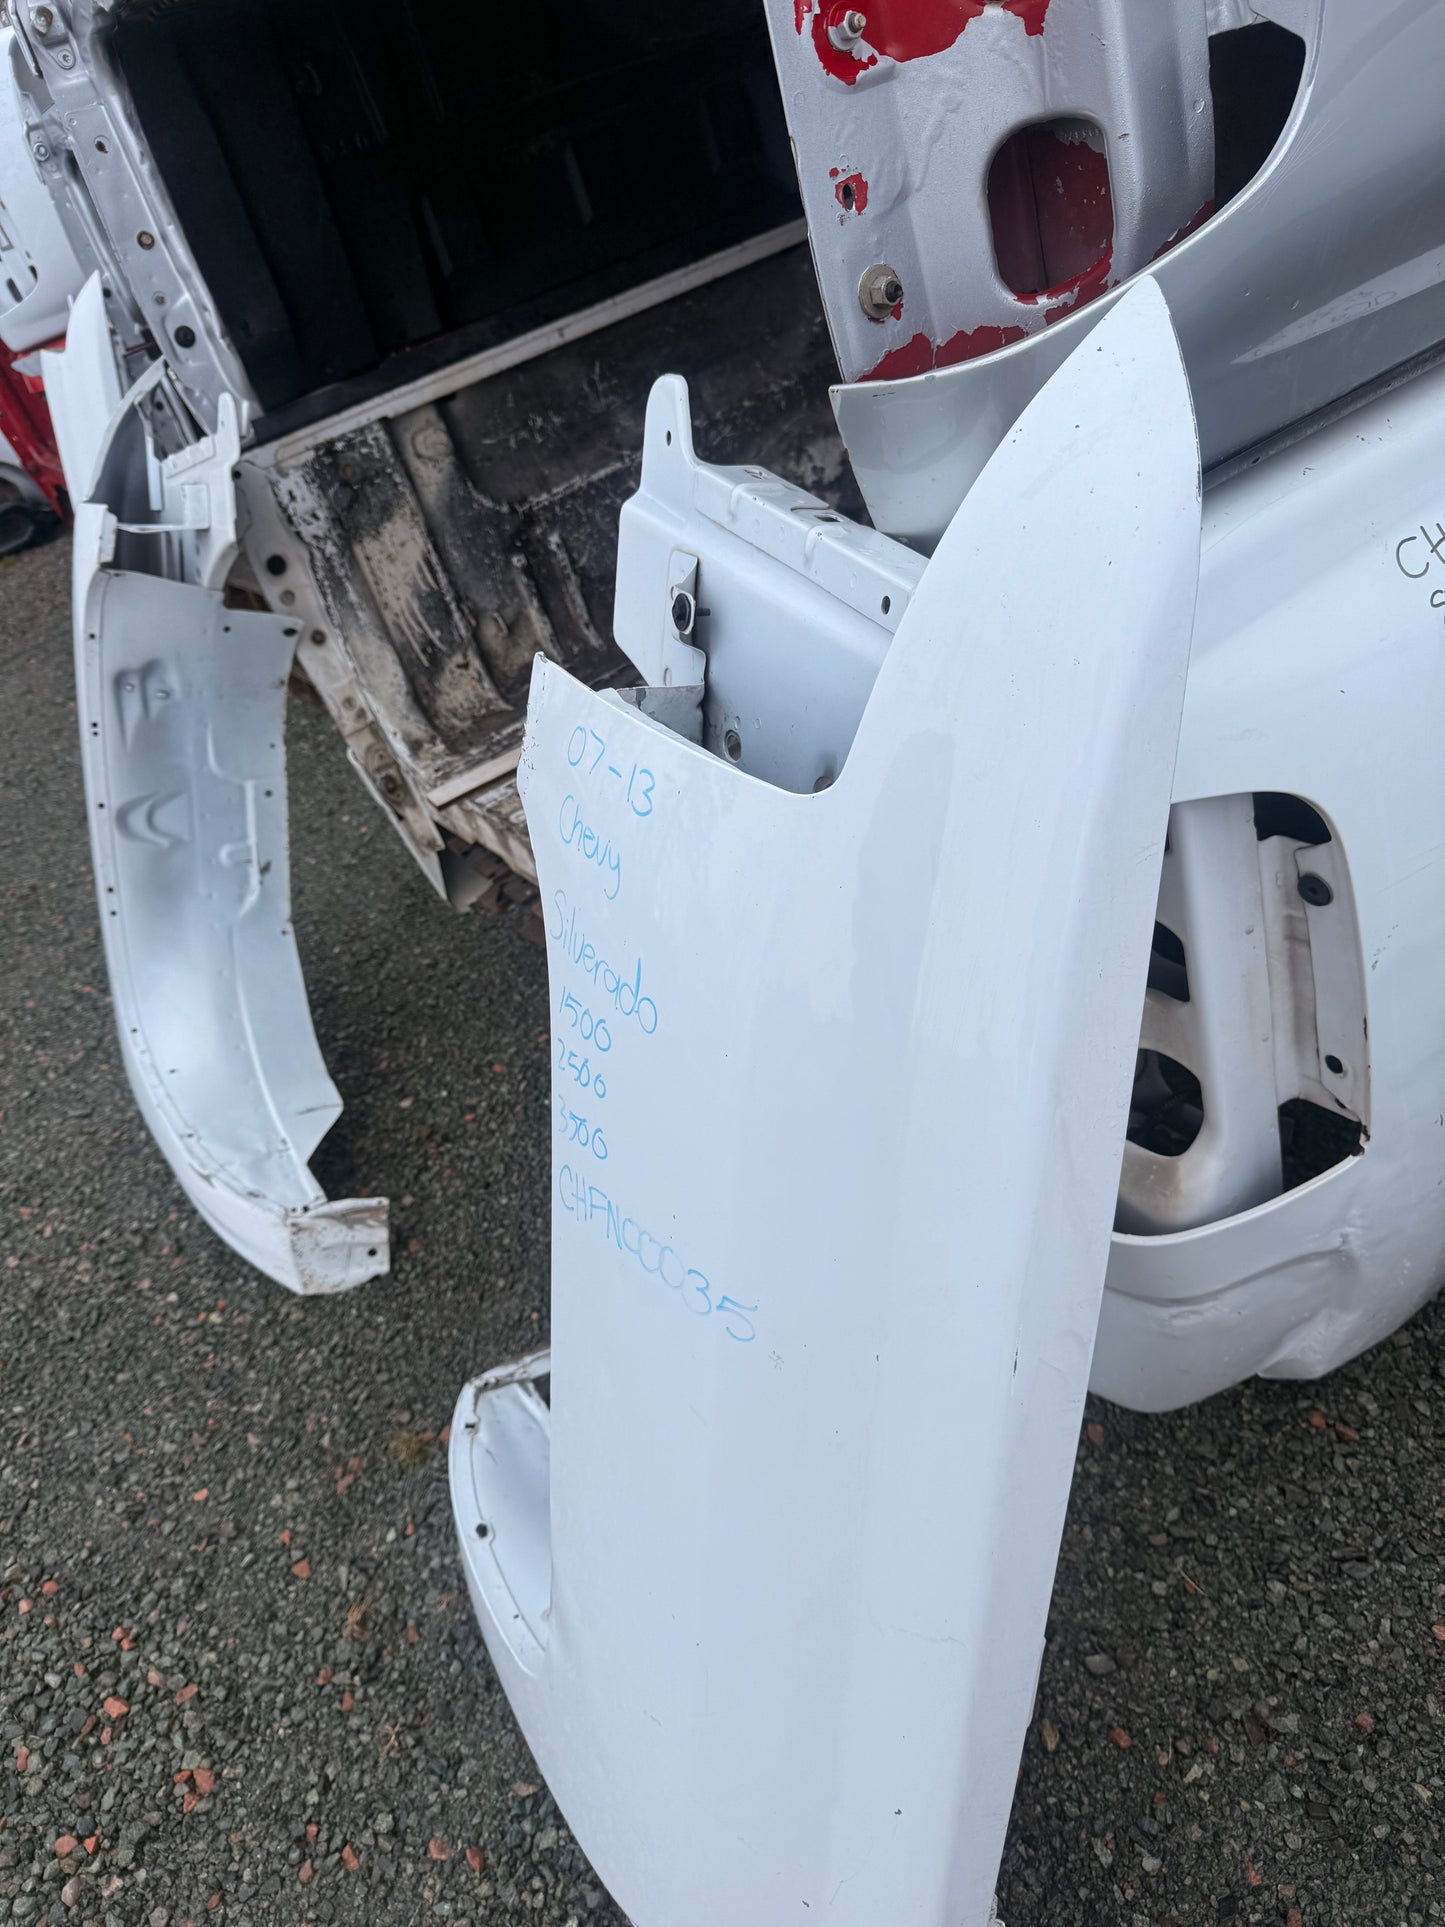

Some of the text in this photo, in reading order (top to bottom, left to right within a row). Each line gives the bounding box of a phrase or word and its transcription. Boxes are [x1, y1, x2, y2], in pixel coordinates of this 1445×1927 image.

[567, 725, 656, 817] 07-13
[559, 794, 621, 900] Chevy
[549, 888, 658, 1034] Silverado
[559, 985, 612, 1051] 1500
[557, 1037, 606, 1099] 2500
[557, 1093, 608, 1160] 3500
